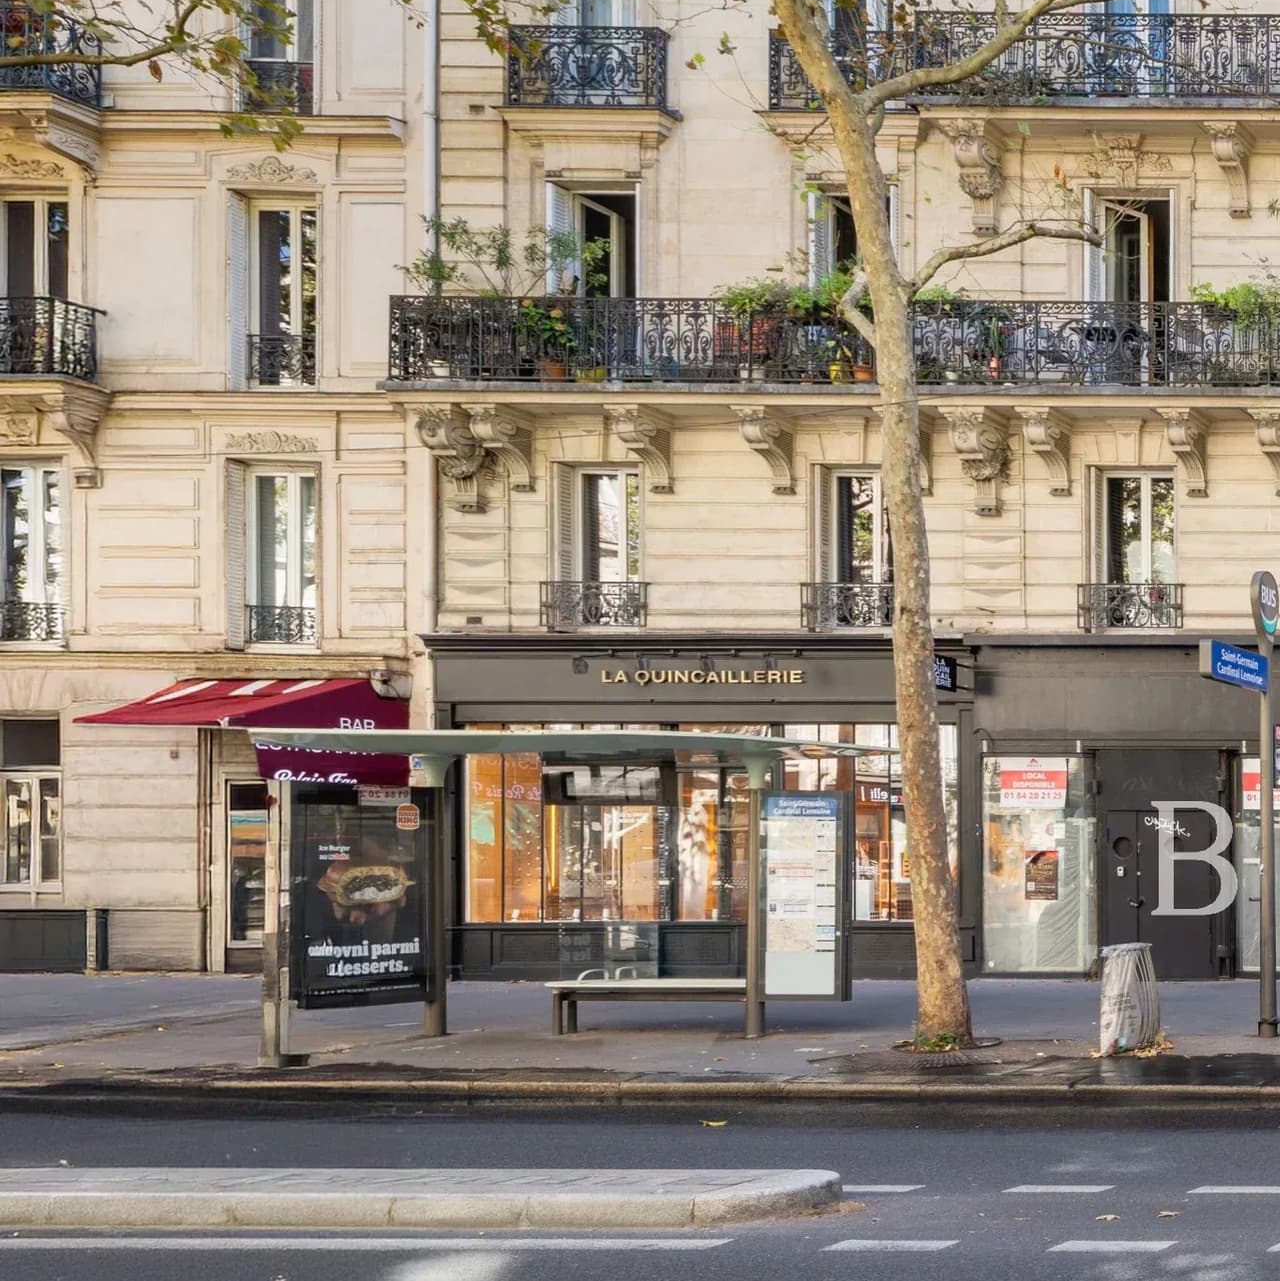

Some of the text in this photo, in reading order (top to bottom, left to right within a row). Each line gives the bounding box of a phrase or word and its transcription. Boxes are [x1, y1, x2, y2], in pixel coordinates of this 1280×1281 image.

[1261, 587, 1277, 608] BUS
[1221, 648, 1259, 671] Saint-Germain
[601, 670, 803, 686] LA QUINCAILLERIE
[1217, 662, 1241, 679] Cardinal
[339, 718, 376, 730] BAR
[1022, 772, 1047, 780] LOCAL
[371, 937, 420, 959] parmi
